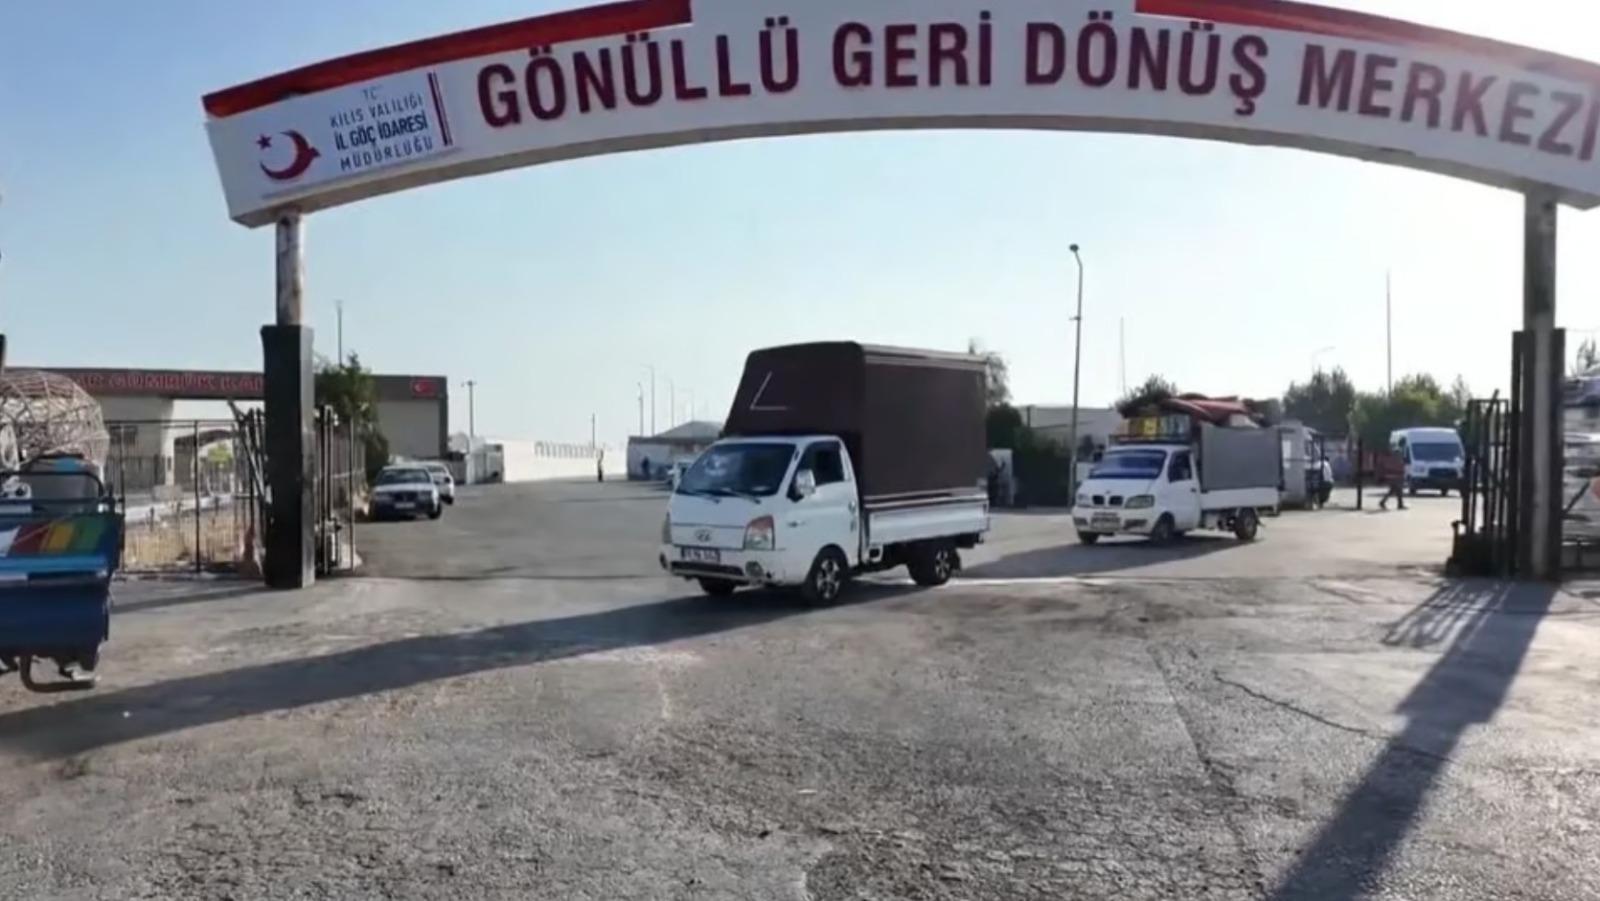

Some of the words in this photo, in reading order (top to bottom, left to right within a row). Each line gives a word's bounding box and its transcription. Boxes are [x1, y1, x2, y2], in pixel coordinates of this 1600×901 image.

[477, 15, 800, 127] GÖNÜLLÜ
[832, 10, 992, 88] GERİ
[1024, 10, 1269, 116] DÖNÜŞ
[349, 124, 377, 148] GÖÇ
